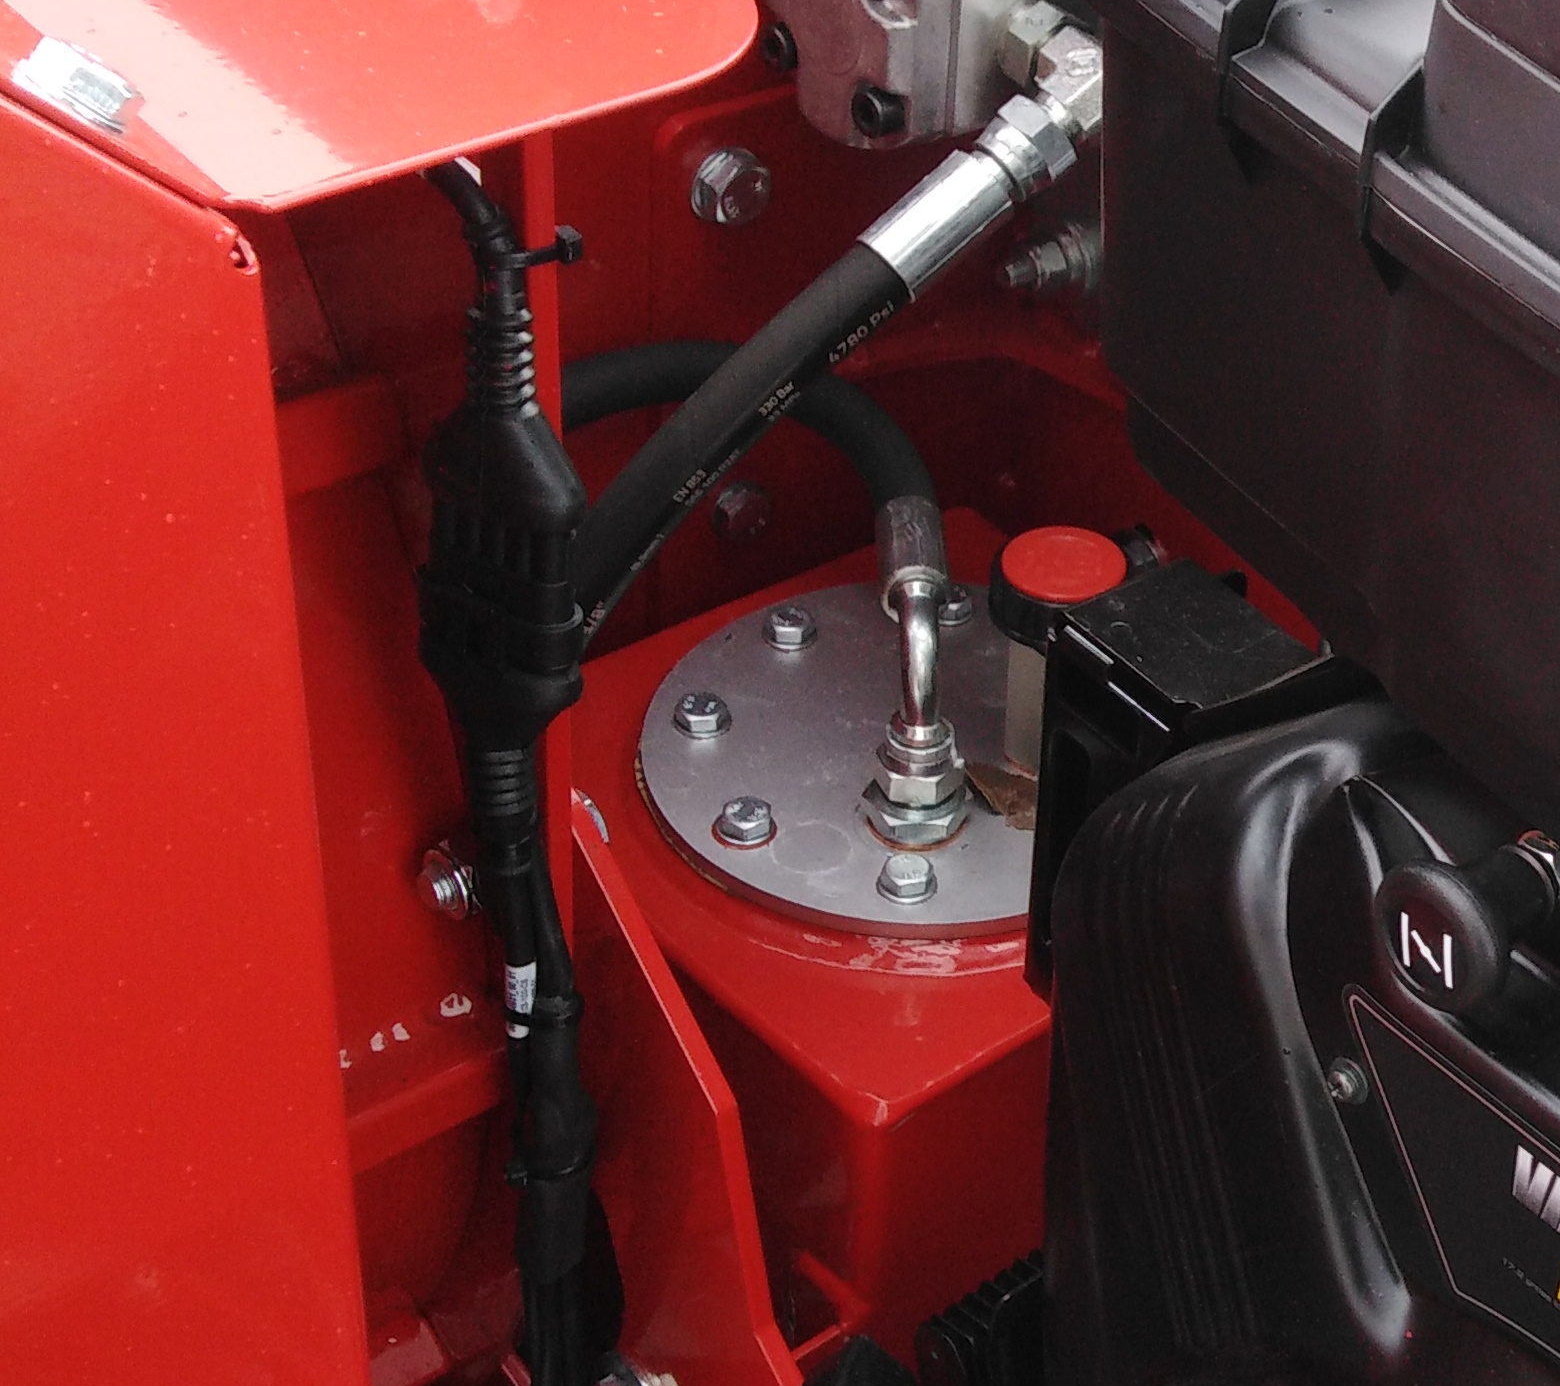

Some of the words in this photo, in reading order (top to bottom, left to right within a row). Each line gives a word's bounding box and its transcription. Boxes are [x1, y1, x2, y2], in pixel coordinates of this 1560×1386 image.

[827, 324, 871, 365] 4780
[865, 298, 897, 328] Psi
[756, 394, 779, 417] 330
[774, 378, 797, 400] Bar
[671, 485, 689, 504] EN
[684, 466, 707, 490] 853
